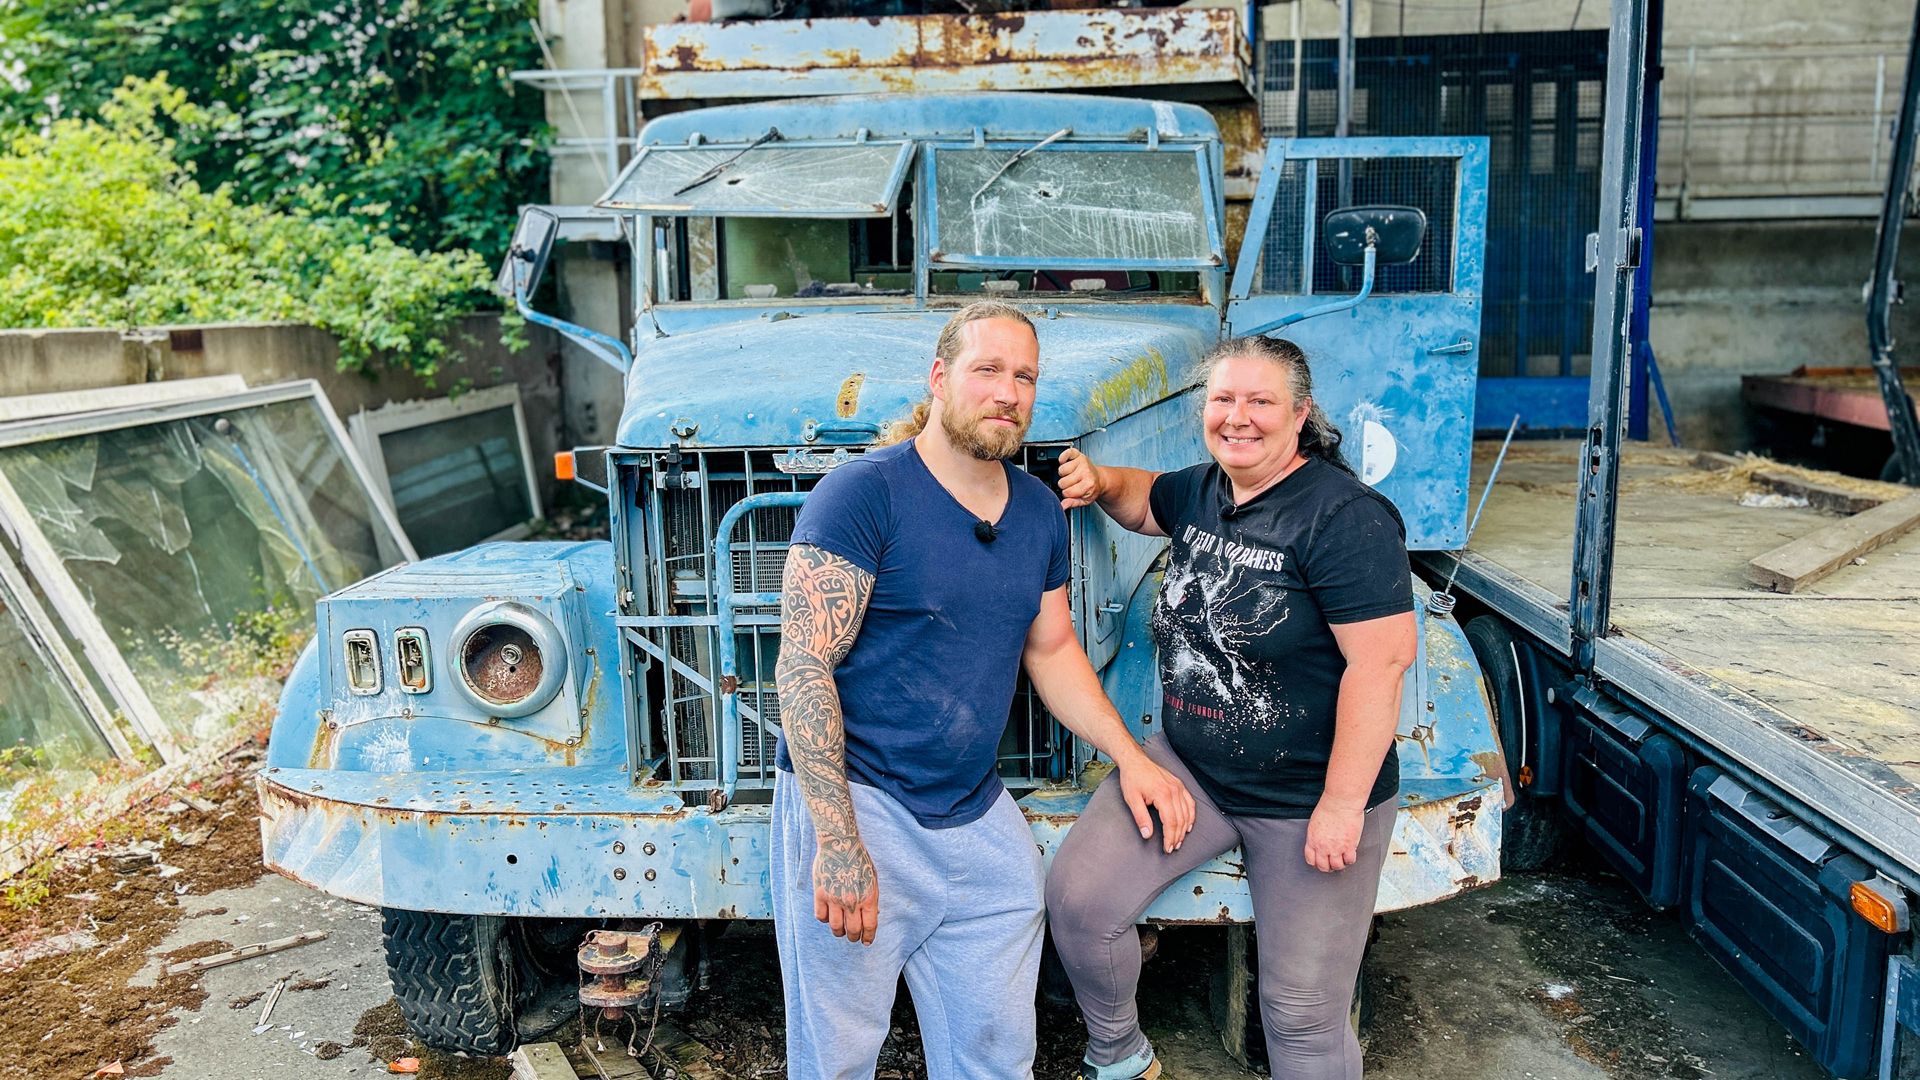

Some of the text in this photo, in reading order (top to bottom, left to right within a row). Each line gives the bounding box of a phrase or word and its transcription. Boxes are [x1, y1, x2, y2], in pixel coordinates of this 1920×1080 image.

[1182, 524, 1197, 544] NO
[1191, 530, 1217, 553] FEAR
[1224, 541, 1285, 572] DARKNESS
[1187, 702, 1225, 720] THUNDER
